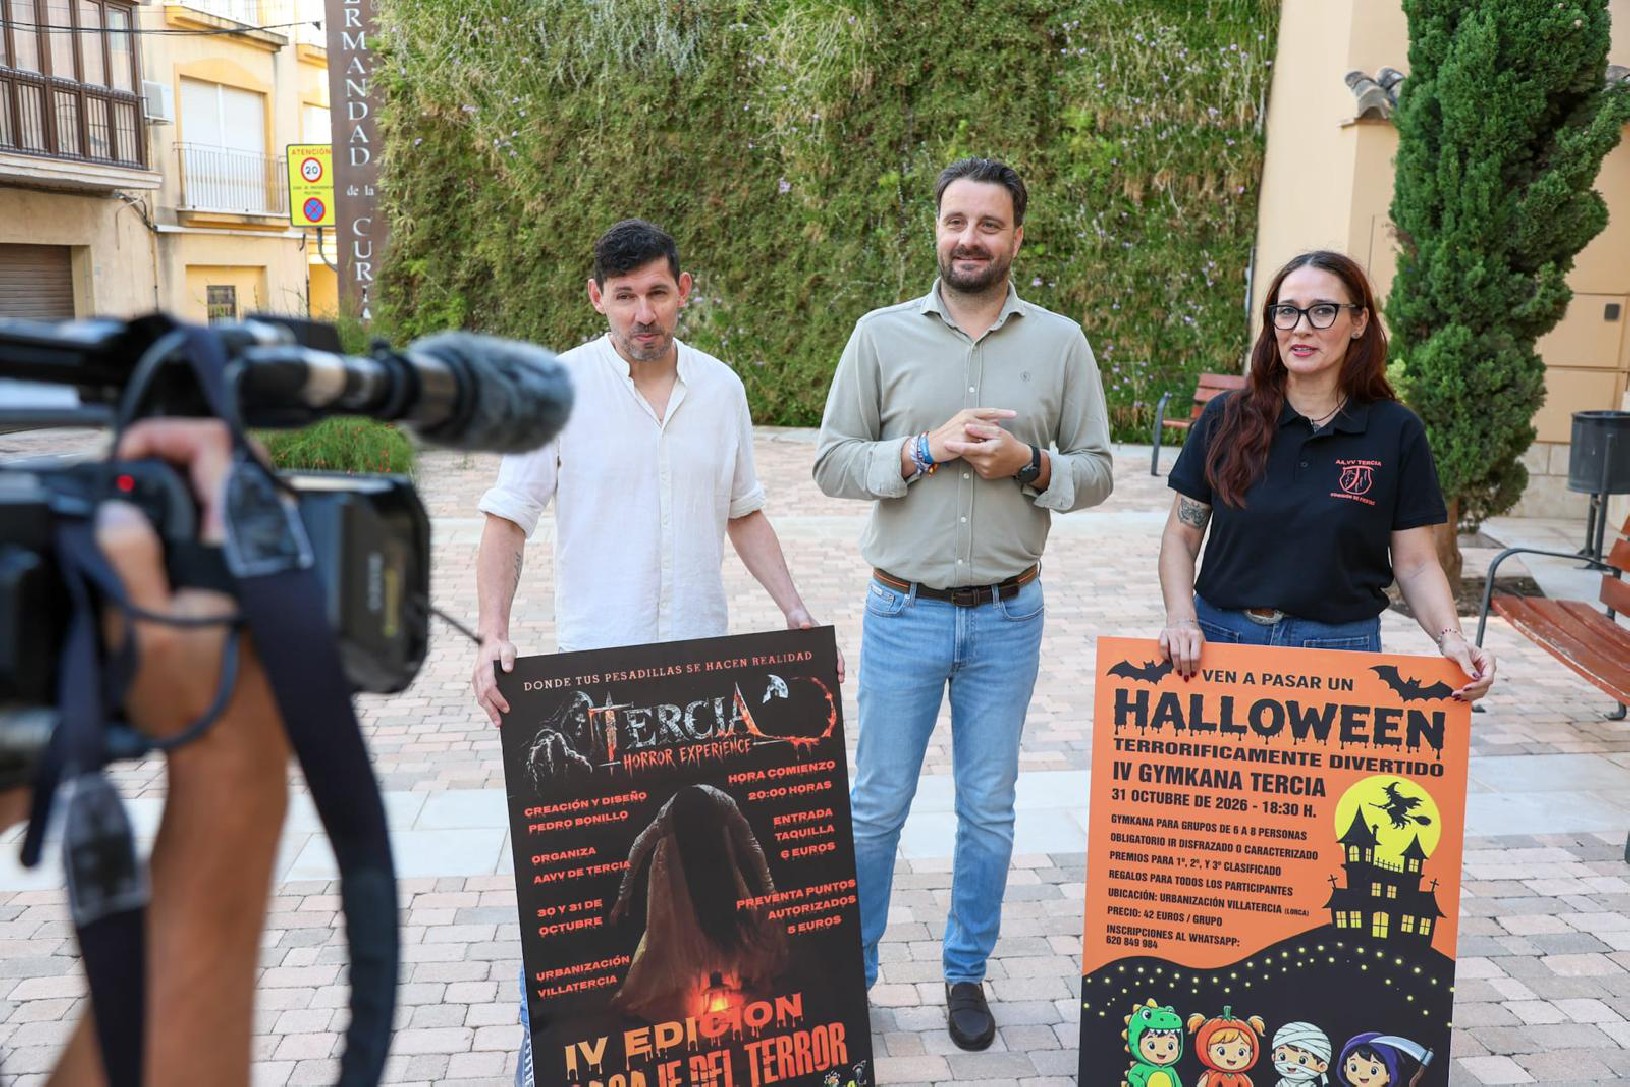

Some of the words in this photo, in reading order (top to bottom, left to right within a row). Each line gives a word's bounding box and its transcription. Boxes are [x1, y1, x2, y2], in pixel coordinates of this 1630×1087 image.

[341, 0, 370, 167] RMANDAD
[305, 166, 318, 175] 20
[346, 185, 359, 196] de
[364, 185, 374, 196] la
[524, 676, 572, 691] DONDE
[575, 674, 600, 686] TUS
[605, 665, 682, 683] PESADILLAS
[686, 663, 701, 674] SE
[706, 658, 748, 672] HACEN
[752, 650, 813, 666] REALIDAD
[1202, 669, 1237, 683] VEN
[1242, 672, 1256, 685] A
[1262, 673, 1321, 689] PASAR
[1328, 677, 1353, 691] UN
[588, 682, 764, 764] TERCIA
[1114, 688, 1446, 758] HALLOWEEN
[623, 748, 676, 774] HORROR
[680, 738, 751, 766] EXPERIENCE
[1113, 738, 1322, 767] TERRORIFICAMENTE
[1329, 754, 1444, 777] DIVERTIDO
[728, 771, 766, 784] HORA
[767, 760, 836, 778] COMIENZO
[1113, 761, 1132, 780] IV
[1139, 764, 1243, 790] GYMKANA
[1251, 773, 1326, 797] TERCIA
[748, 787, 787, 800] 20:00
[788, 781, 832, 794] HORAS
[524, 799, 589, 818] CREACIÓN
[591, 799, 600, 807] Y
[602, 790, 647, 805] DISEÑO
[1112, 788, 1126, 800] 31
[1131, 790, 1189, 806] OCTUBRE
[1194, 795, 1211, 808] DE
[1215, 797, 1248, 811] 2026
[1262, 801, 1299, 816] 18:30
[1303, 804, 1317, 818] H.
[528, 819, 573, 833] PEDRO
[575, 810, 629, 826] BONILLO
[773, 808, 833, 826] ENTRADA
[1111, 814, 1154, 827] GYMKANA
[1156, 819, 1179, 829] PARA
[1181, 821, 1217, 832] GRUPOS
[1219, 824, 1231, 834] DE
[1233, 826, 1239, 834] 6
[1241, 826, 1247, 835] A
[1250, 827, 1256, 836] 8
[1258, 828, 1307, 840] PERSONAS
[774, 825, 835, 841] TAQUILLA
[531, 847, 596, 864] ORGANIZA
[780, 850, 790, 859] 6
[792, 842, 836, 857] EUROS
[1110, 833, 1165, 846] OBLIGATORIO
[1168, 838, 1177, 847] IR
[1179, 839, 1233, 852] DISFRAZADO
[1235, 844, 1241, 853] O
[1244, 845, 1318, 860] CARACTERIZADO
[533, 870, 565, 885] AAVV
[568, 867, 584, 878] DE
[586, 860, 631, 875] TERCIA
[1109, 851, 1149, 863] PREMIOS
[1151, 855, 1174, 865] PARA
[1205, 860, 1211, 869] Y
[1224, 862, 1281, 876] CLASIFICADO
[736, 889, 804, 910] PREVENTA
[805, 879, 856, 895] PUNTOS
[1109, 870, 1148, 882] REGALOS
[1150, 874, 1172, 884] PARA
[1175, 876, 1204, 888] TODOS
[1206, 879, 1222, 889] LOS
[1225, 881, 1293, 896] PARTICIPANTES
[537, 907, 557, 918] 30
[558, 905, 567, 915] Y
[569, 902, 582, 912] 31
[584, 899, 603, 909] DE
[768, 895, 856, 919] AUTORIZADOS
[1160, 893, 1224, 908] URBANIZACIÓN
[1227, 900, 1282, 913] VILLATERCIA
[538, 917, 603, 936] OCTUBRE
[787, 925, 796, 934] 5
[797, 915, 842, 931] EUROS
[1107, 906, 1141, 917] PRECIO:
[1144, 910, 1154, 919] 42
[1156, 911, 1185, 922] EUROS
[1192, 915, 1222, 927] GRUPO
[1106, 925, 1173, 940] INSCRIPCIONES
[1175, 932, 1186, 941] AL
[1189, 933, 1240, 947] WHATSAPP:
[1106, 936, 1121, 945] 620
[1124, 937, 1139, 947] 849
[1142, 939, 1158, 949] 984
[536, 954, 630, 981] URBANIZACIÓN
[537, 975, 618, 998] VILLATERCIA
[565, 1036, 608, 1078] IV
[744, 1022, 848, 1087] TERROR
